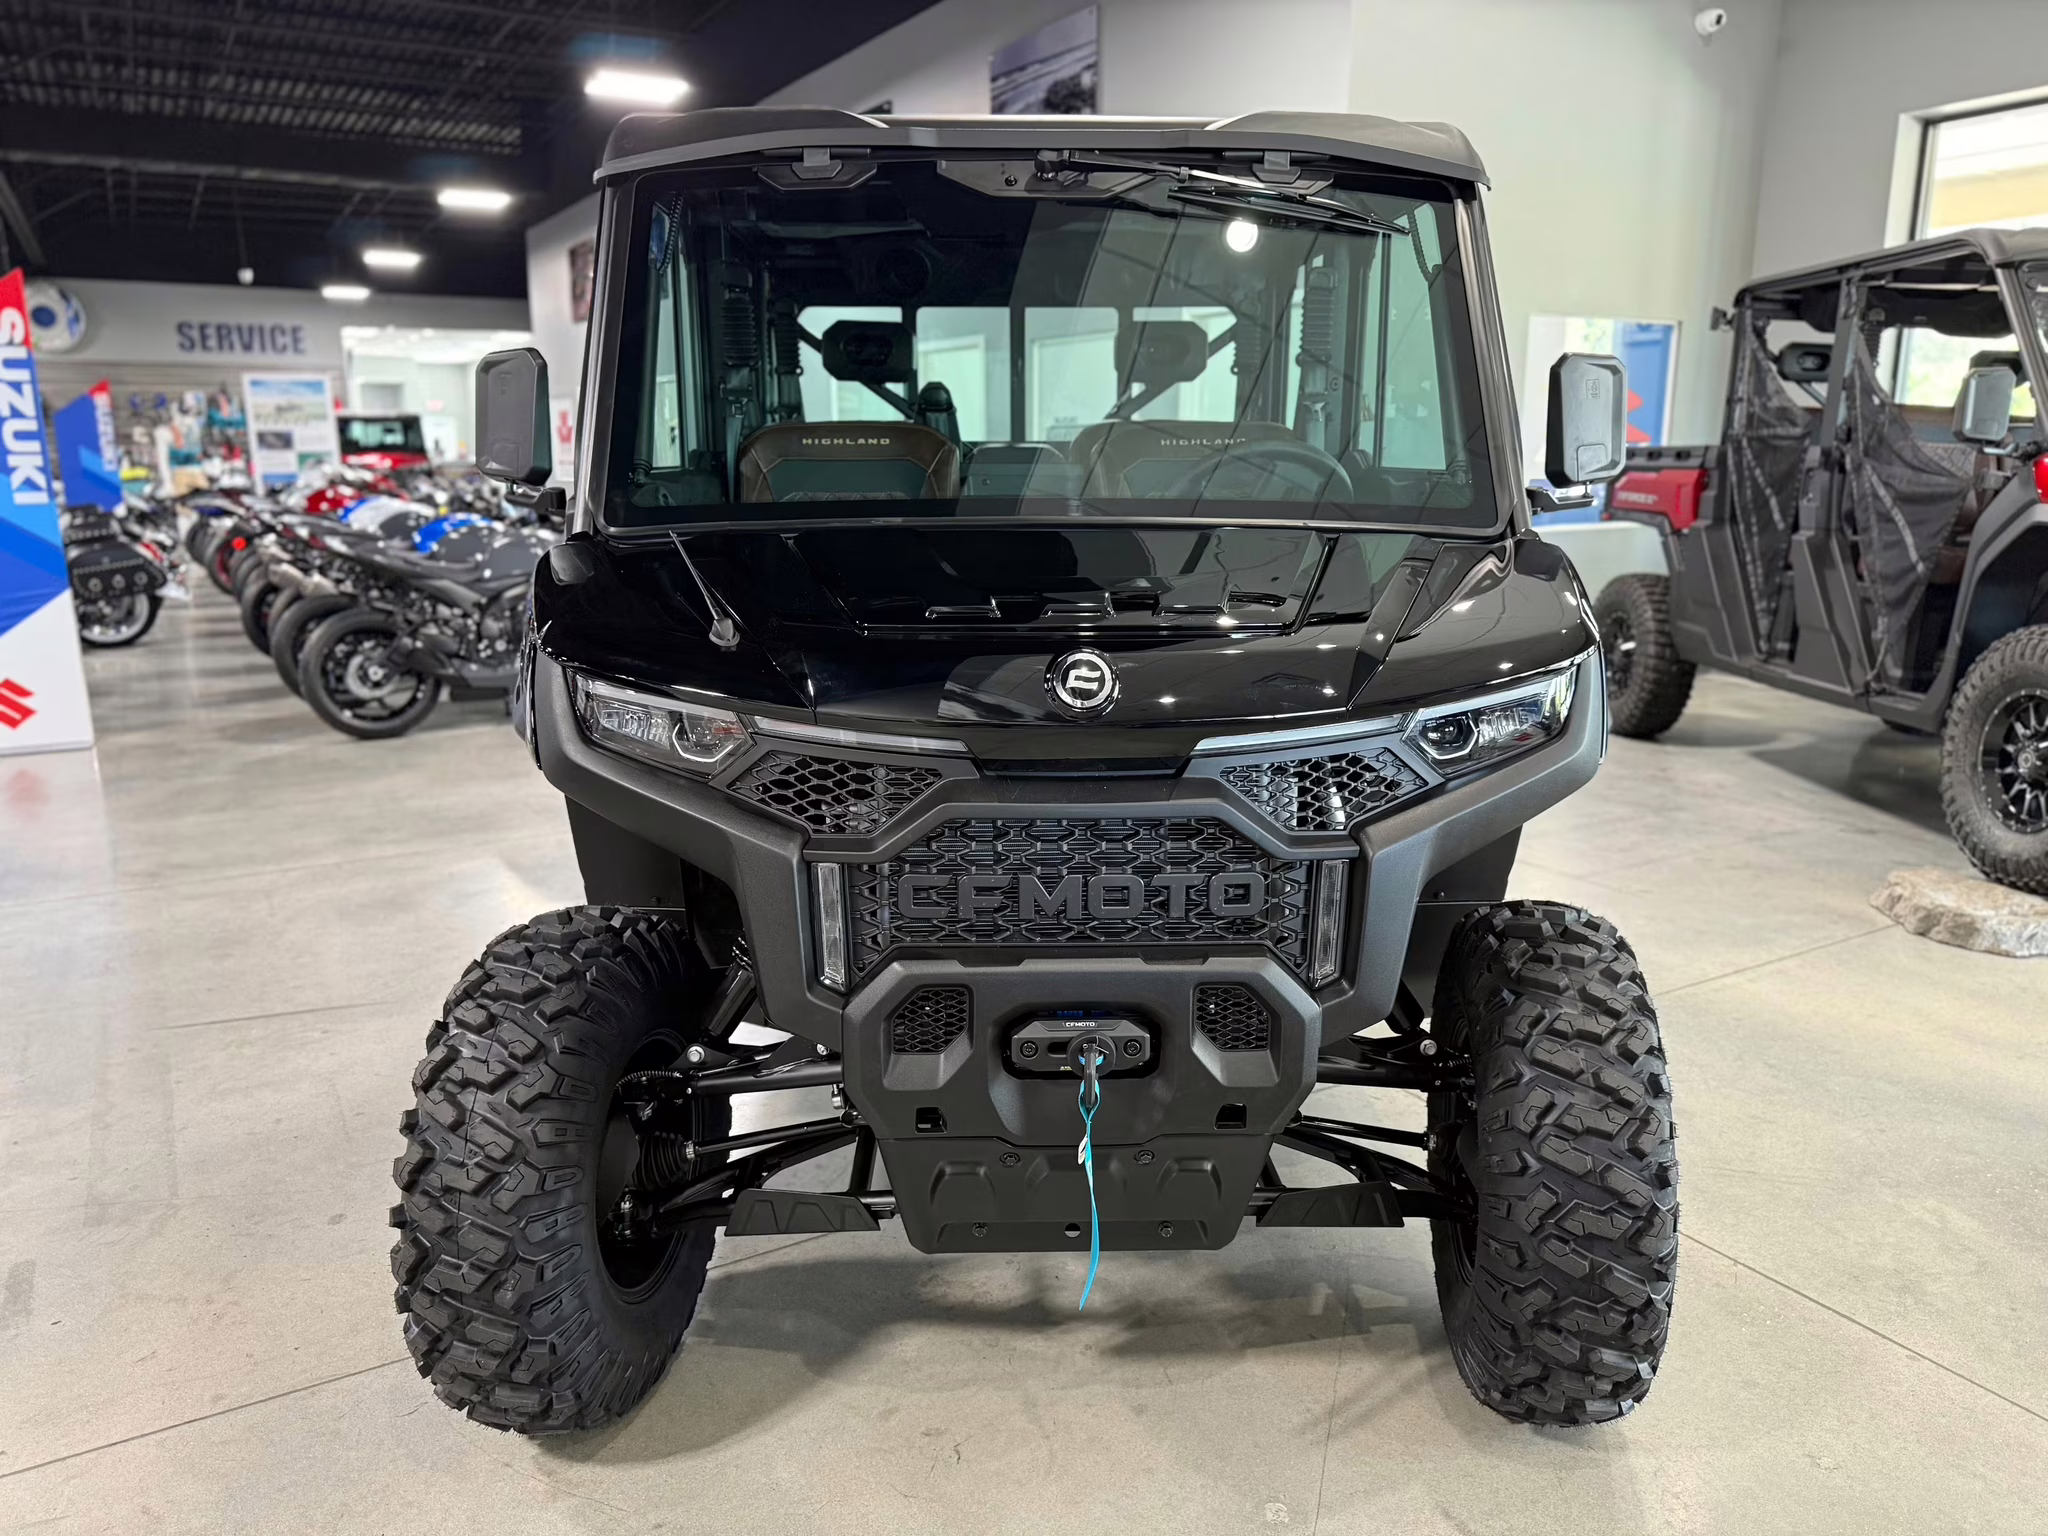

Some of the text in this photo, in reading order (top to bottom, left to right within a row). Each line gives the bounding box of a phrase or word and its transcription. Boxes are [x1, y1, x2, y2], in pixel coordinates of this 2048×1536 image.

[176, 320, 307, 356] SERVICE
[0, 306, 50, 506] SUZUKI
[898, 872, 1265, 920] CFMOTO
